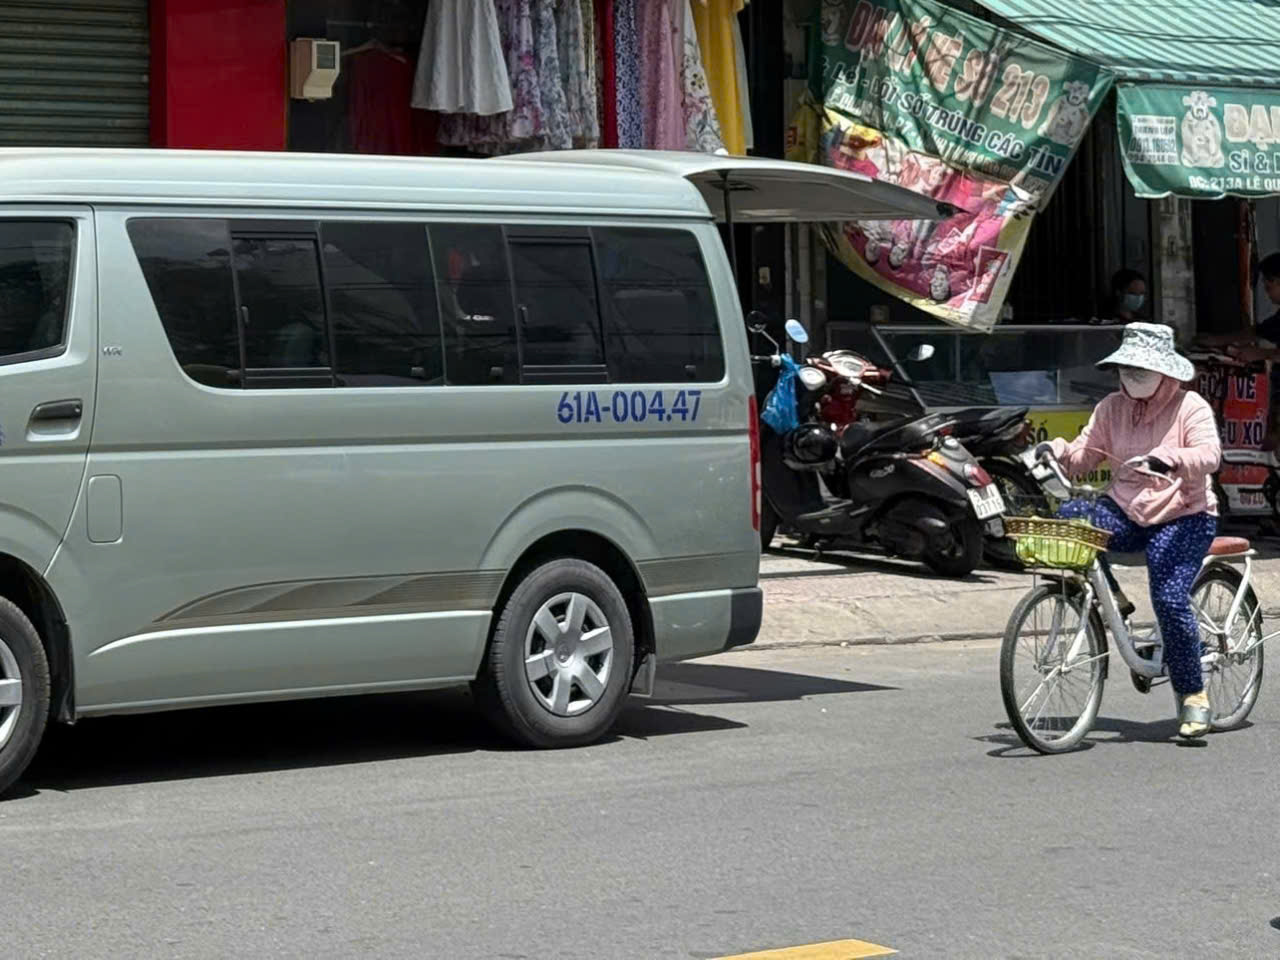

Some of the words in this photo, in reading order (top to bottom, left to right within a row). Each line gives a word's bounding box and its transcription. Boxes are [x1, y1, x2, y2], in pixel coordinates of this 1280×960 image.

[990, 63, 1050, 129] 213
[926, 103, 987, 146] TRÚNG
[984, 130, 1025, 161] CÁC
[557, 390, 702, 424] 61A-004.47
